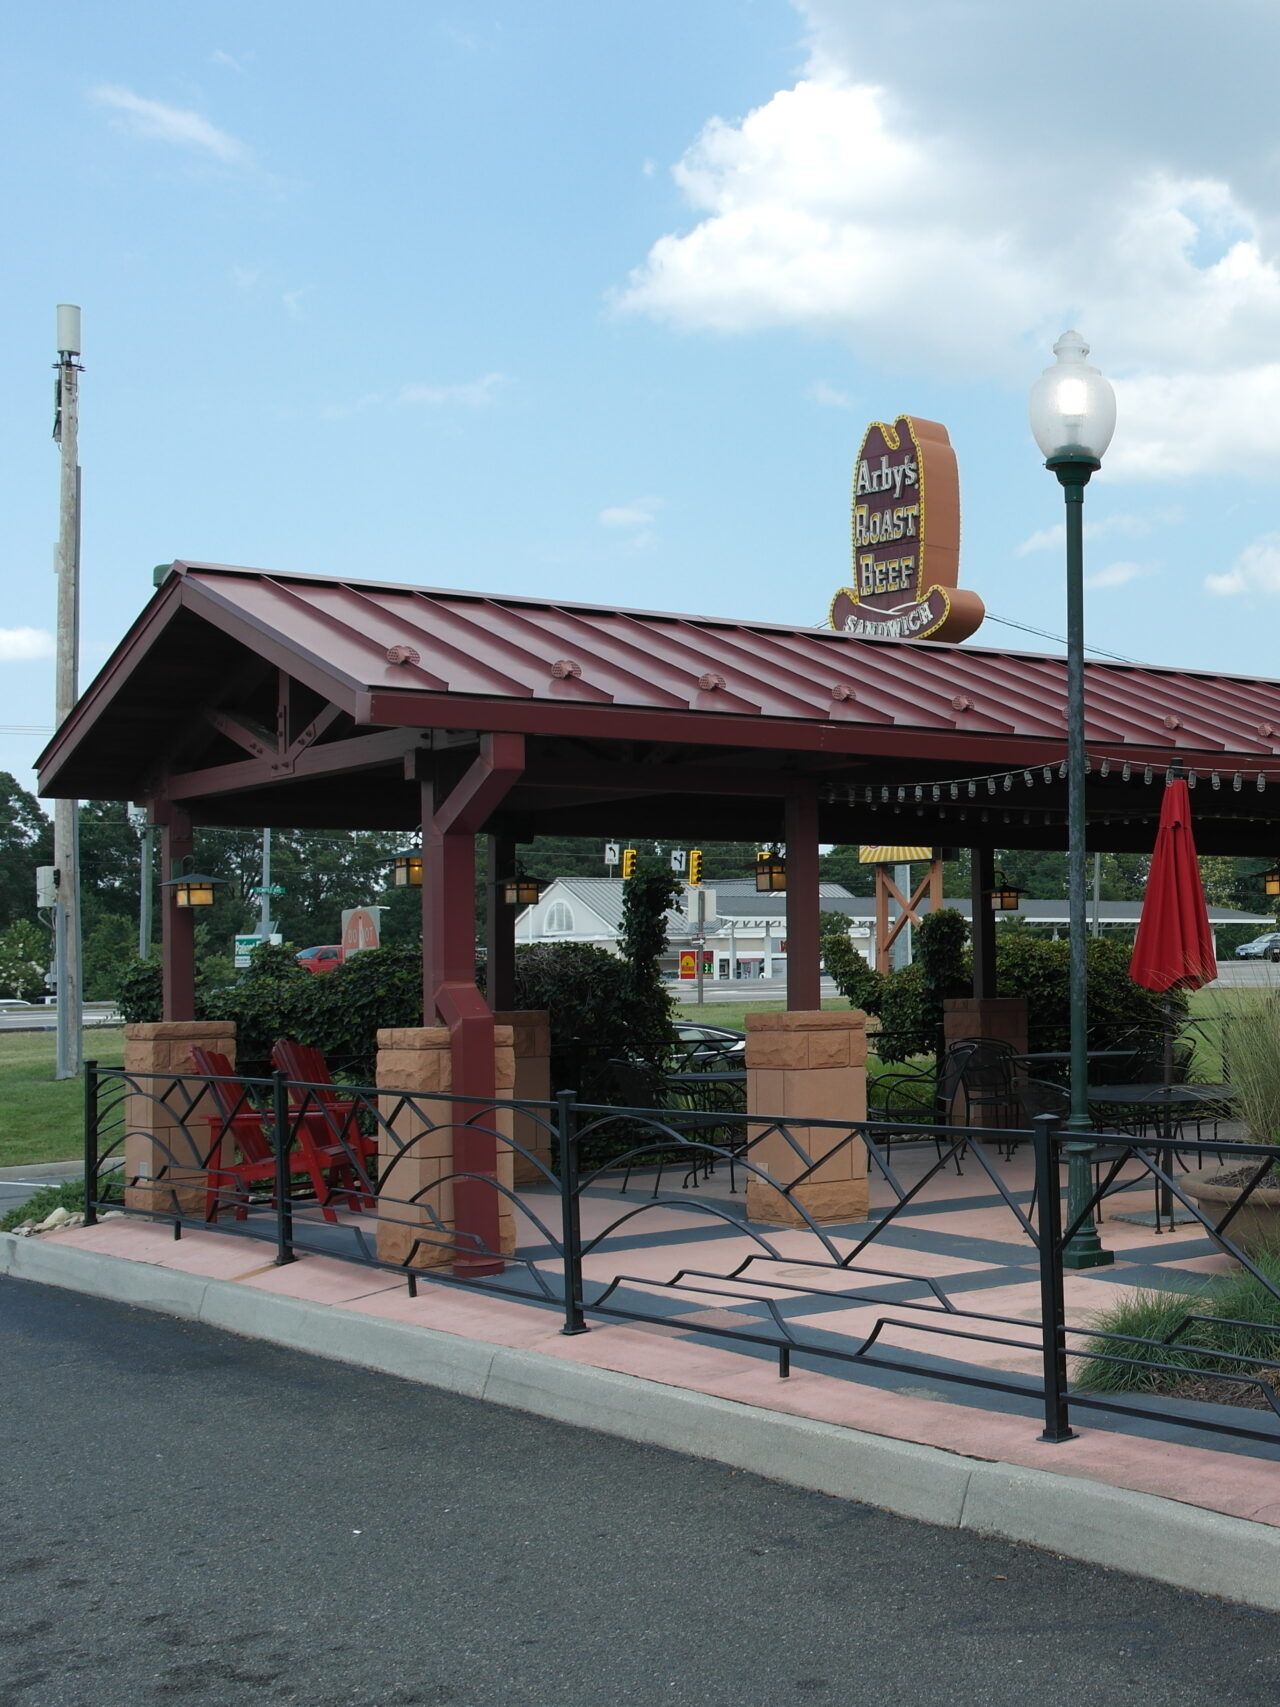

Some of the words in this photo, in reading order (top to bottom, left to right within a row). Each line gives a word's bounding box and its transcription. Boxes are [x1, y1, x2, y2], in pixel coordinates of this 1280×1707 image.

[855, 504, 919, 547] ROAST
[860, 553, 915, 596] BEEF
[843, 602, 934, 637] SANDWICH
[347, 928, 357, 944] DO
